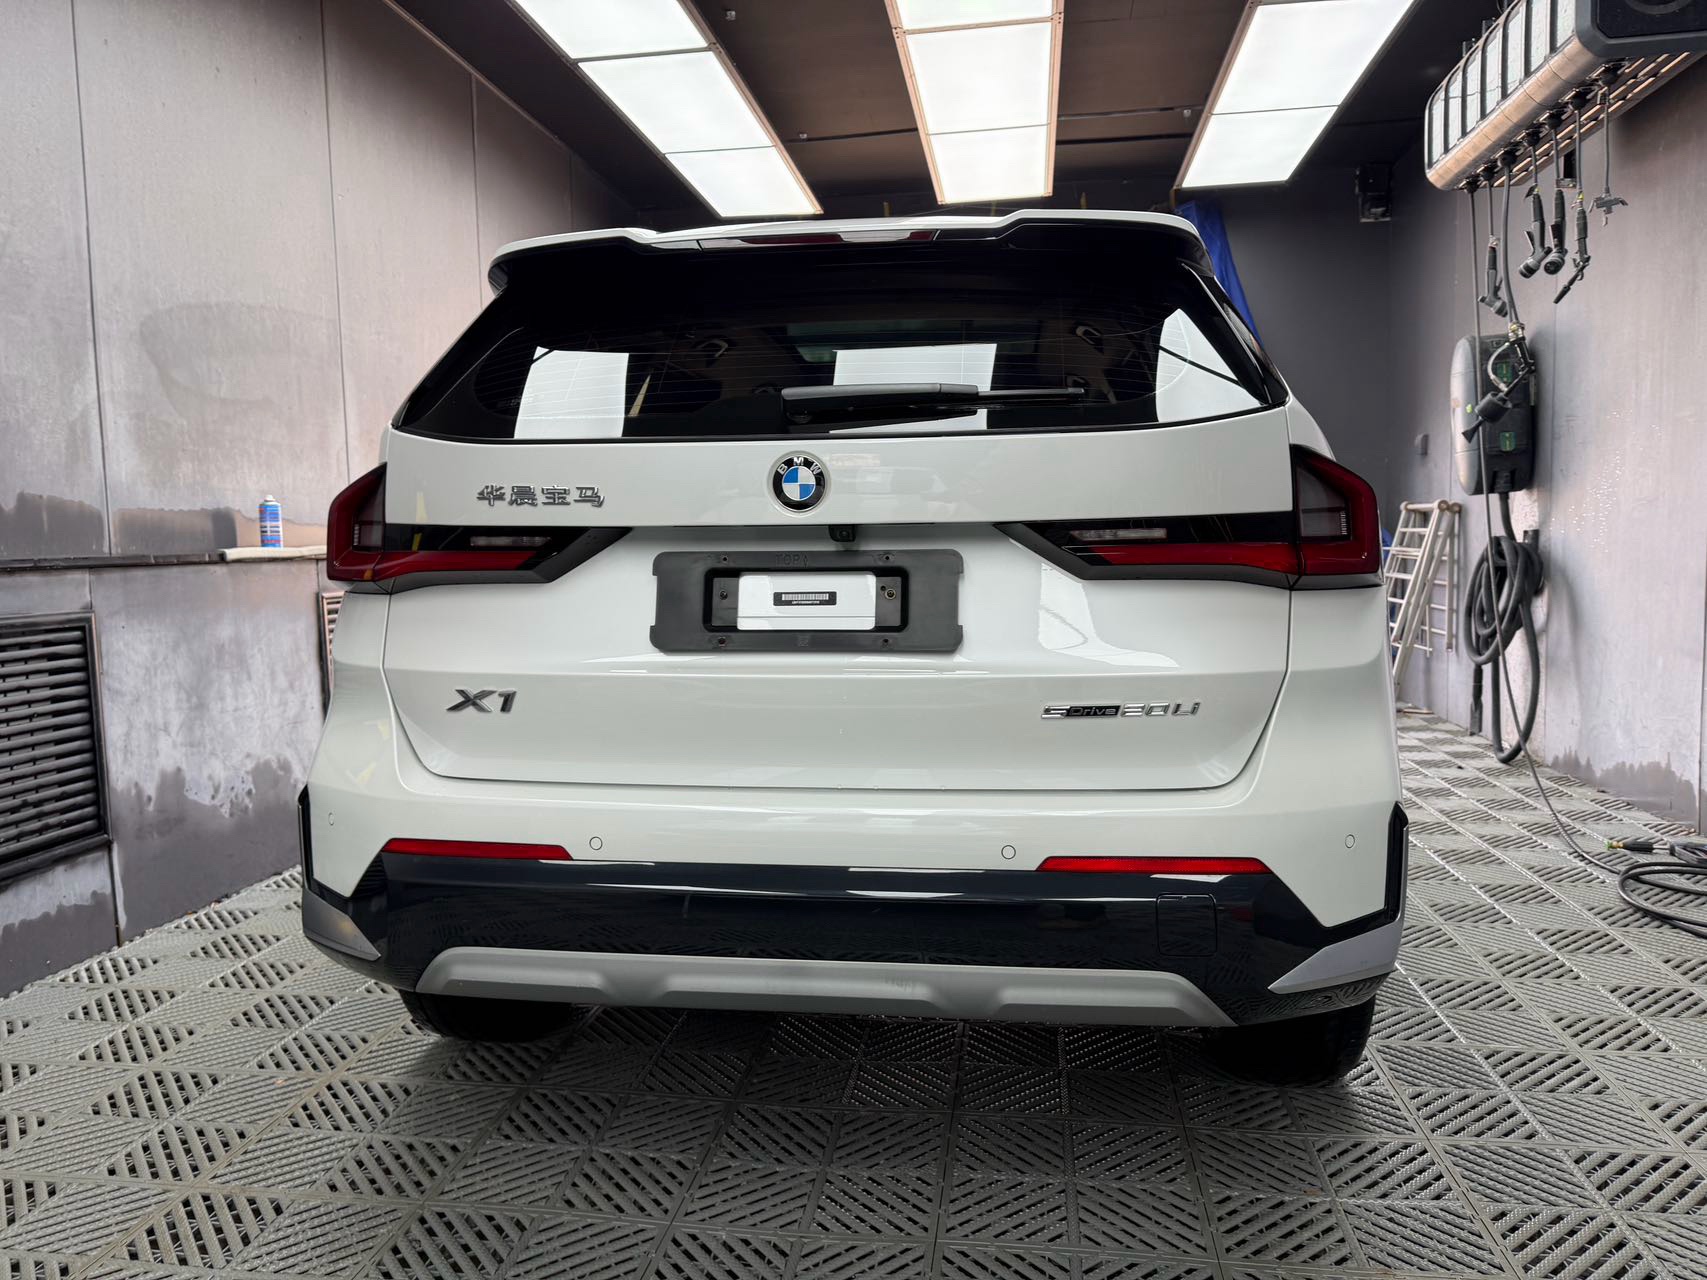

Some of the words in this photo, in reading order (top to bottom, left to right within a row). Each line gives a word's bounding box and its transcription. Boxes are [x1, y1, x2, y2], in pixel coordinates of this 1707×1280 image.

[777, 457, 821, 475] BMW
[477, 485, 605, 508] 华晨宝马
[446, 688, 517, 713] X1
